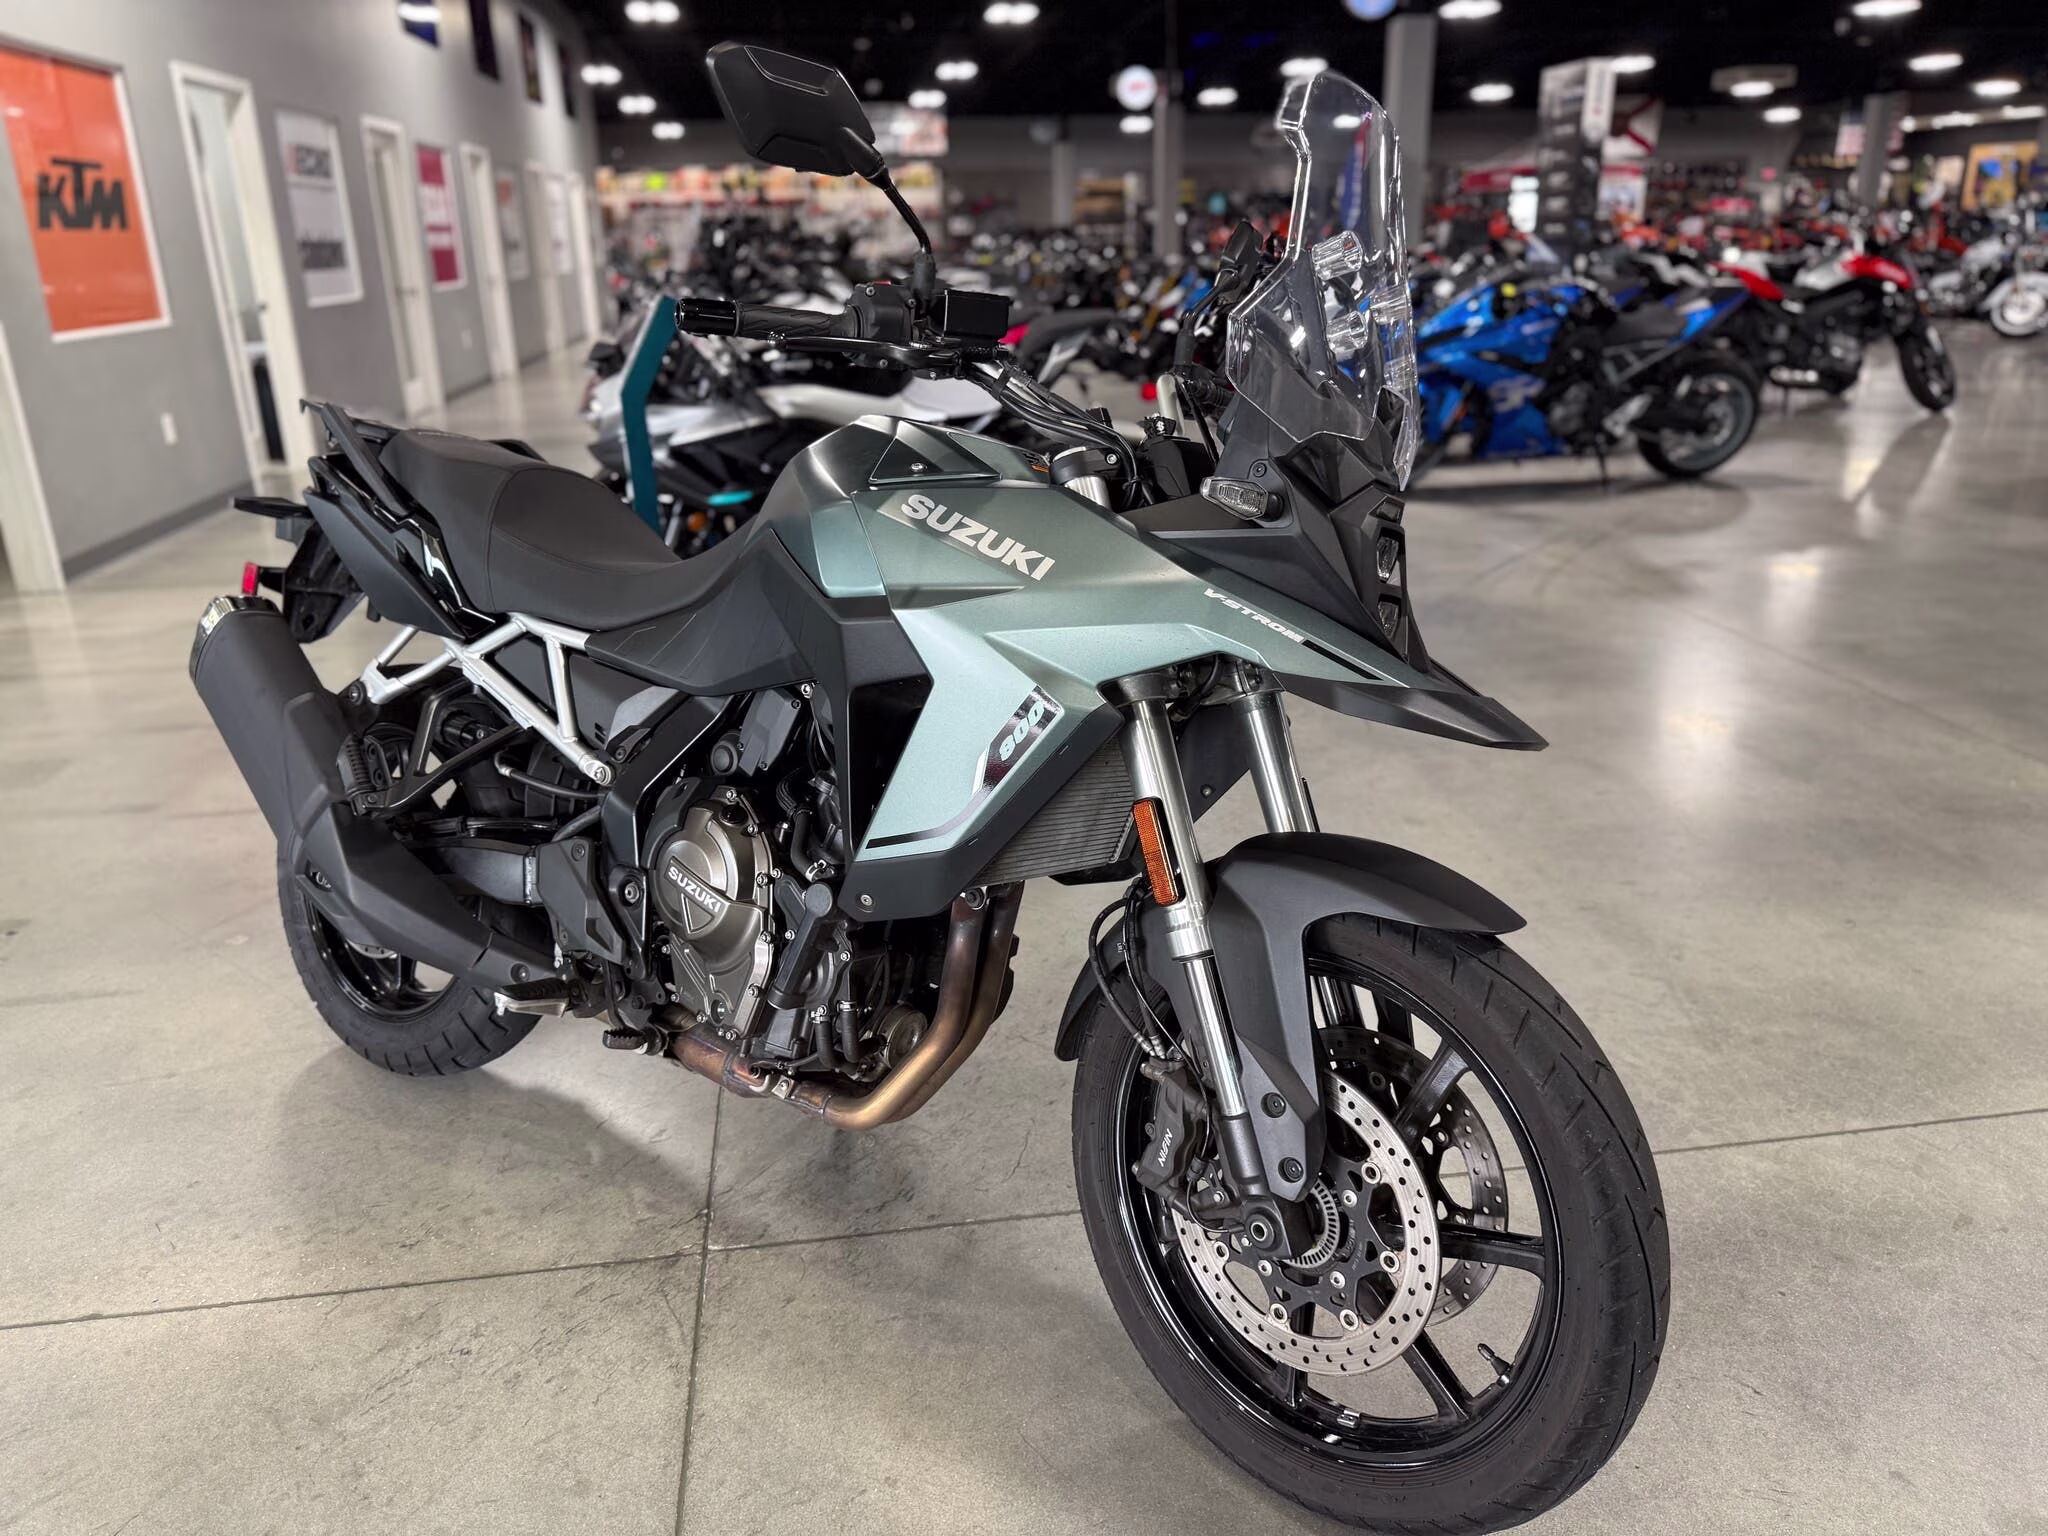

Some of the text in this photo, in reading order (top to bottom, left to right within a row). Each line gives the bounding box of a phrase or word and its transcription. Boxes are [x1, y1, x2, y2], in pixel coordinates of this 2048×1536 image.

[37, 157, 127, 229] KTM
[901, 494, 1055, 581] SUZUKI
[1203, 588, 1304, 643] V-STROM
[999, 700, 1045, 762] 800
[668, 866, 722, 913] SUZUKI
